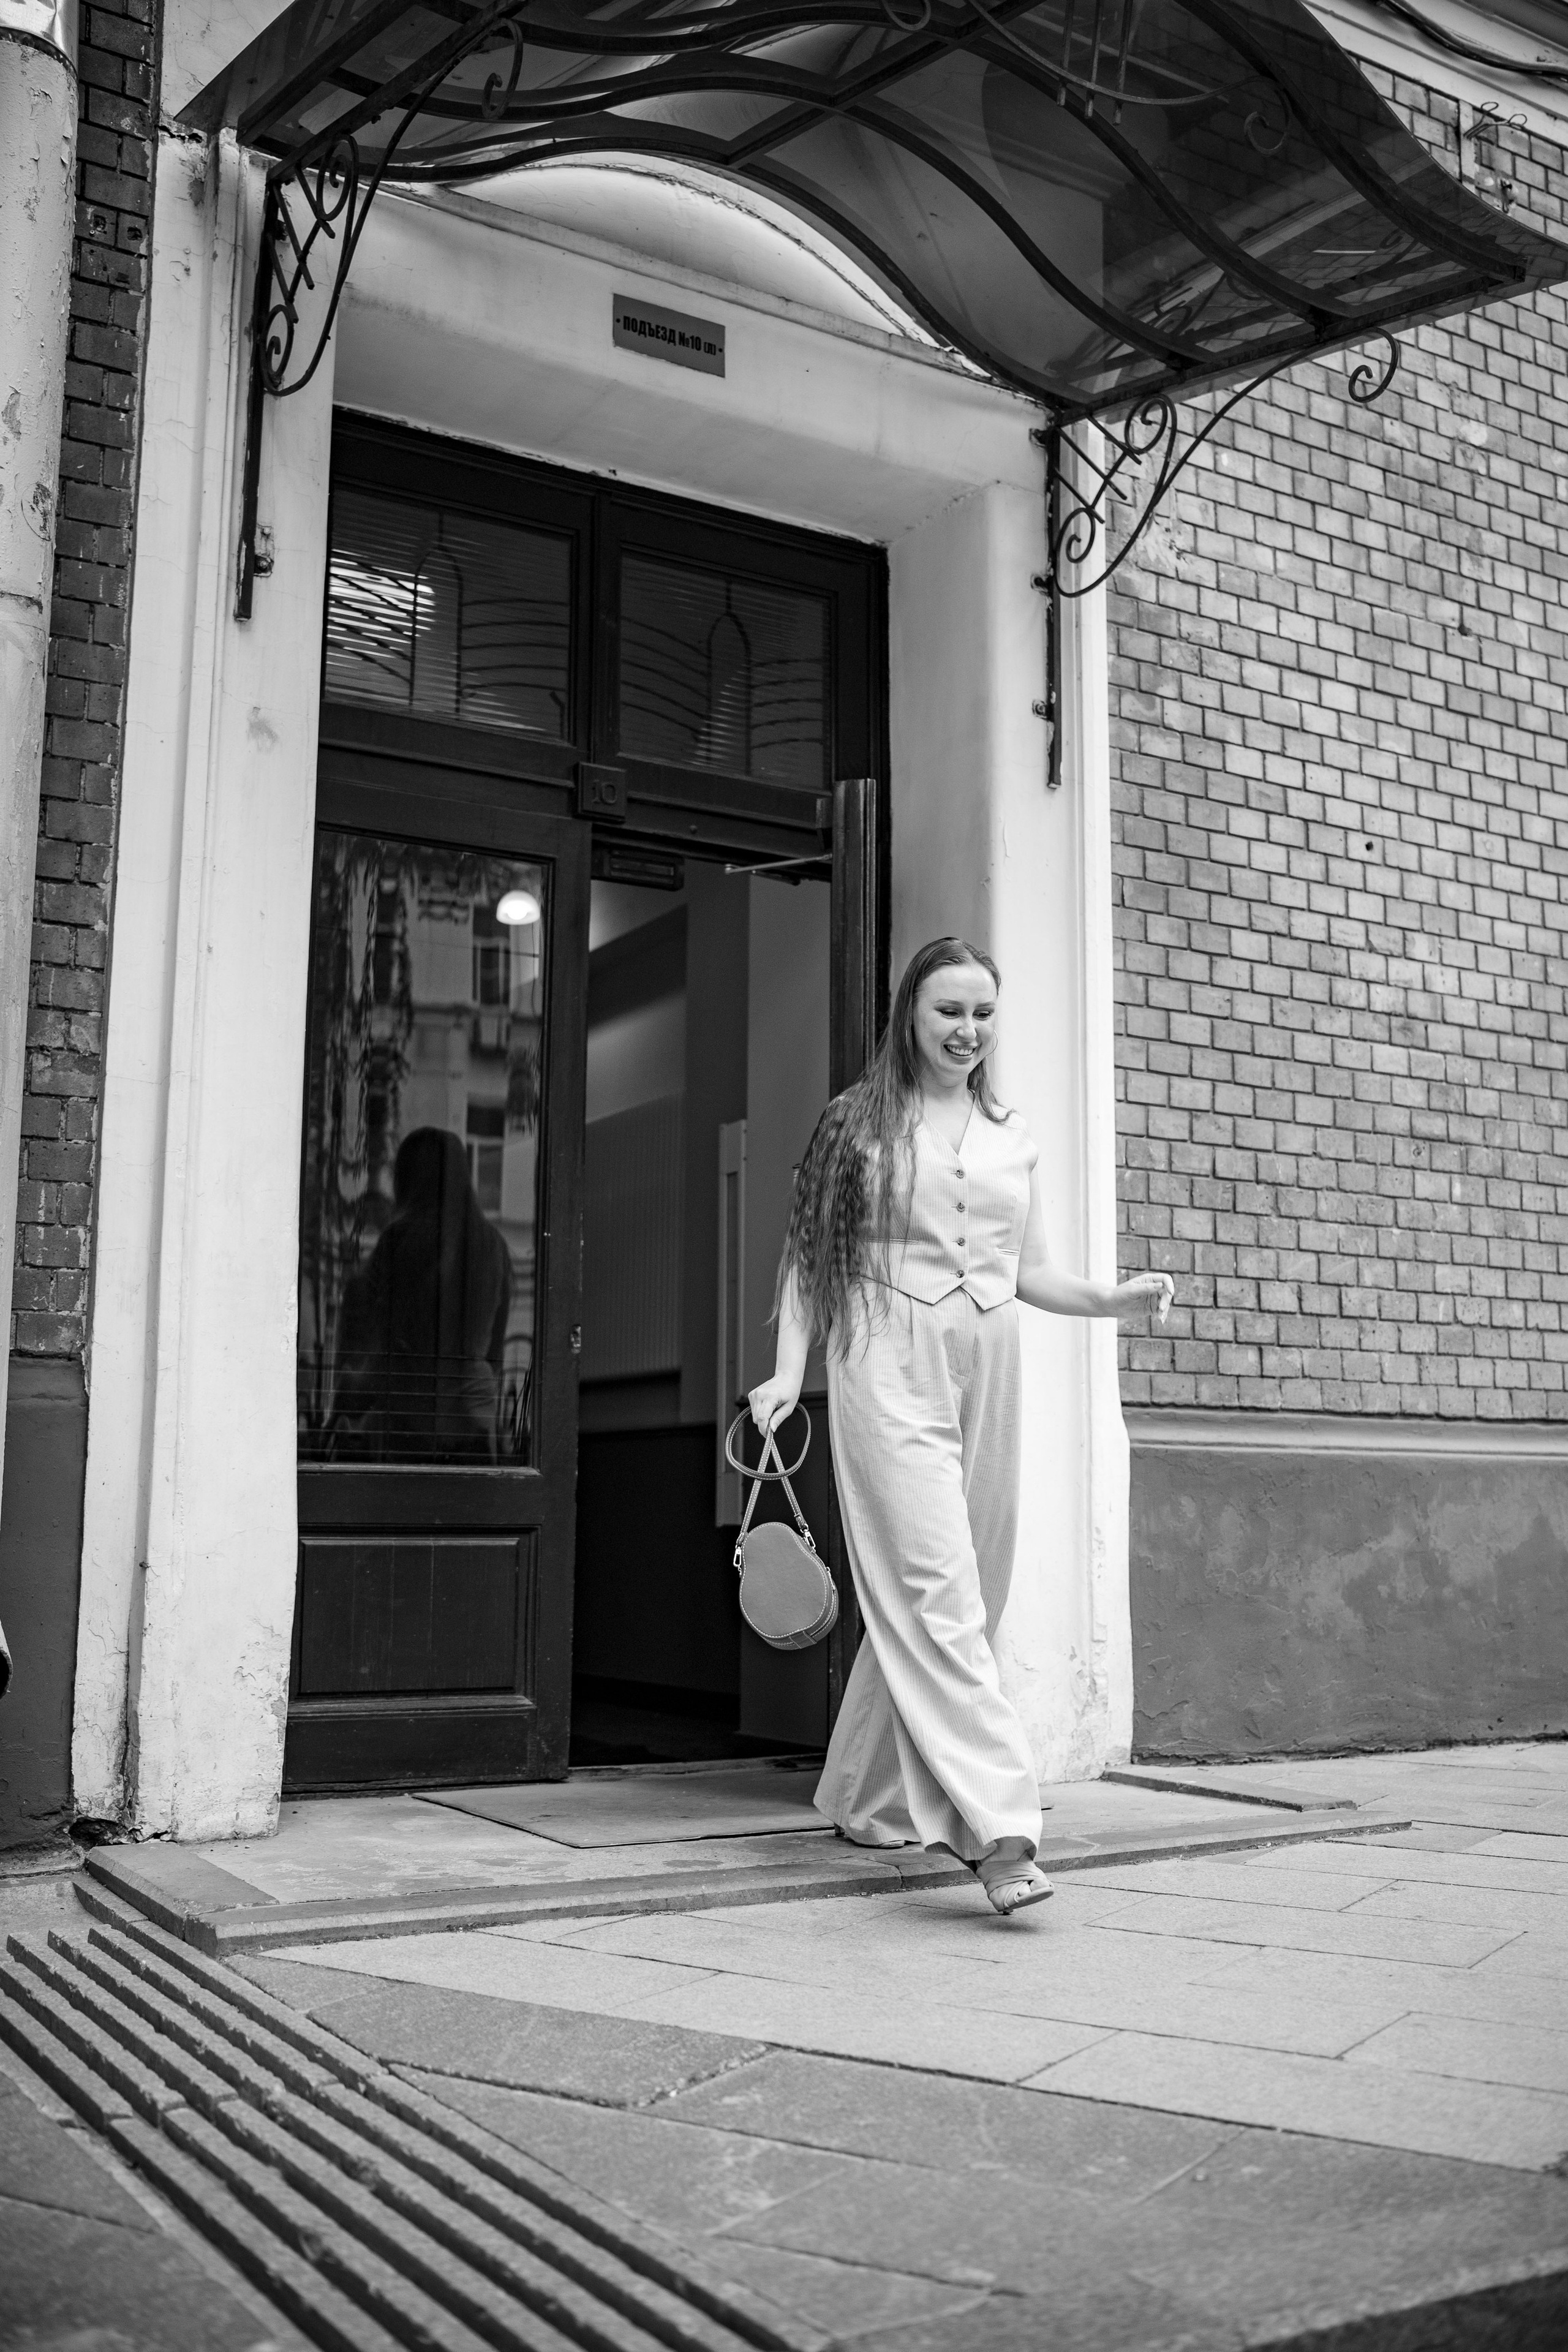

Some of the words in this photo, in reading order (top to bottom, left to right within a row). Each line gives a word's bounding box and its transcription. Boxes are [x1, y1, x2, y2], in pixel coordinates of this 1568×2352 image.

[623, 315, 676, 346] ПОДЪЕЗД
[678, 331, 701, 351] №10
[591, 779, 617, 804] 10
